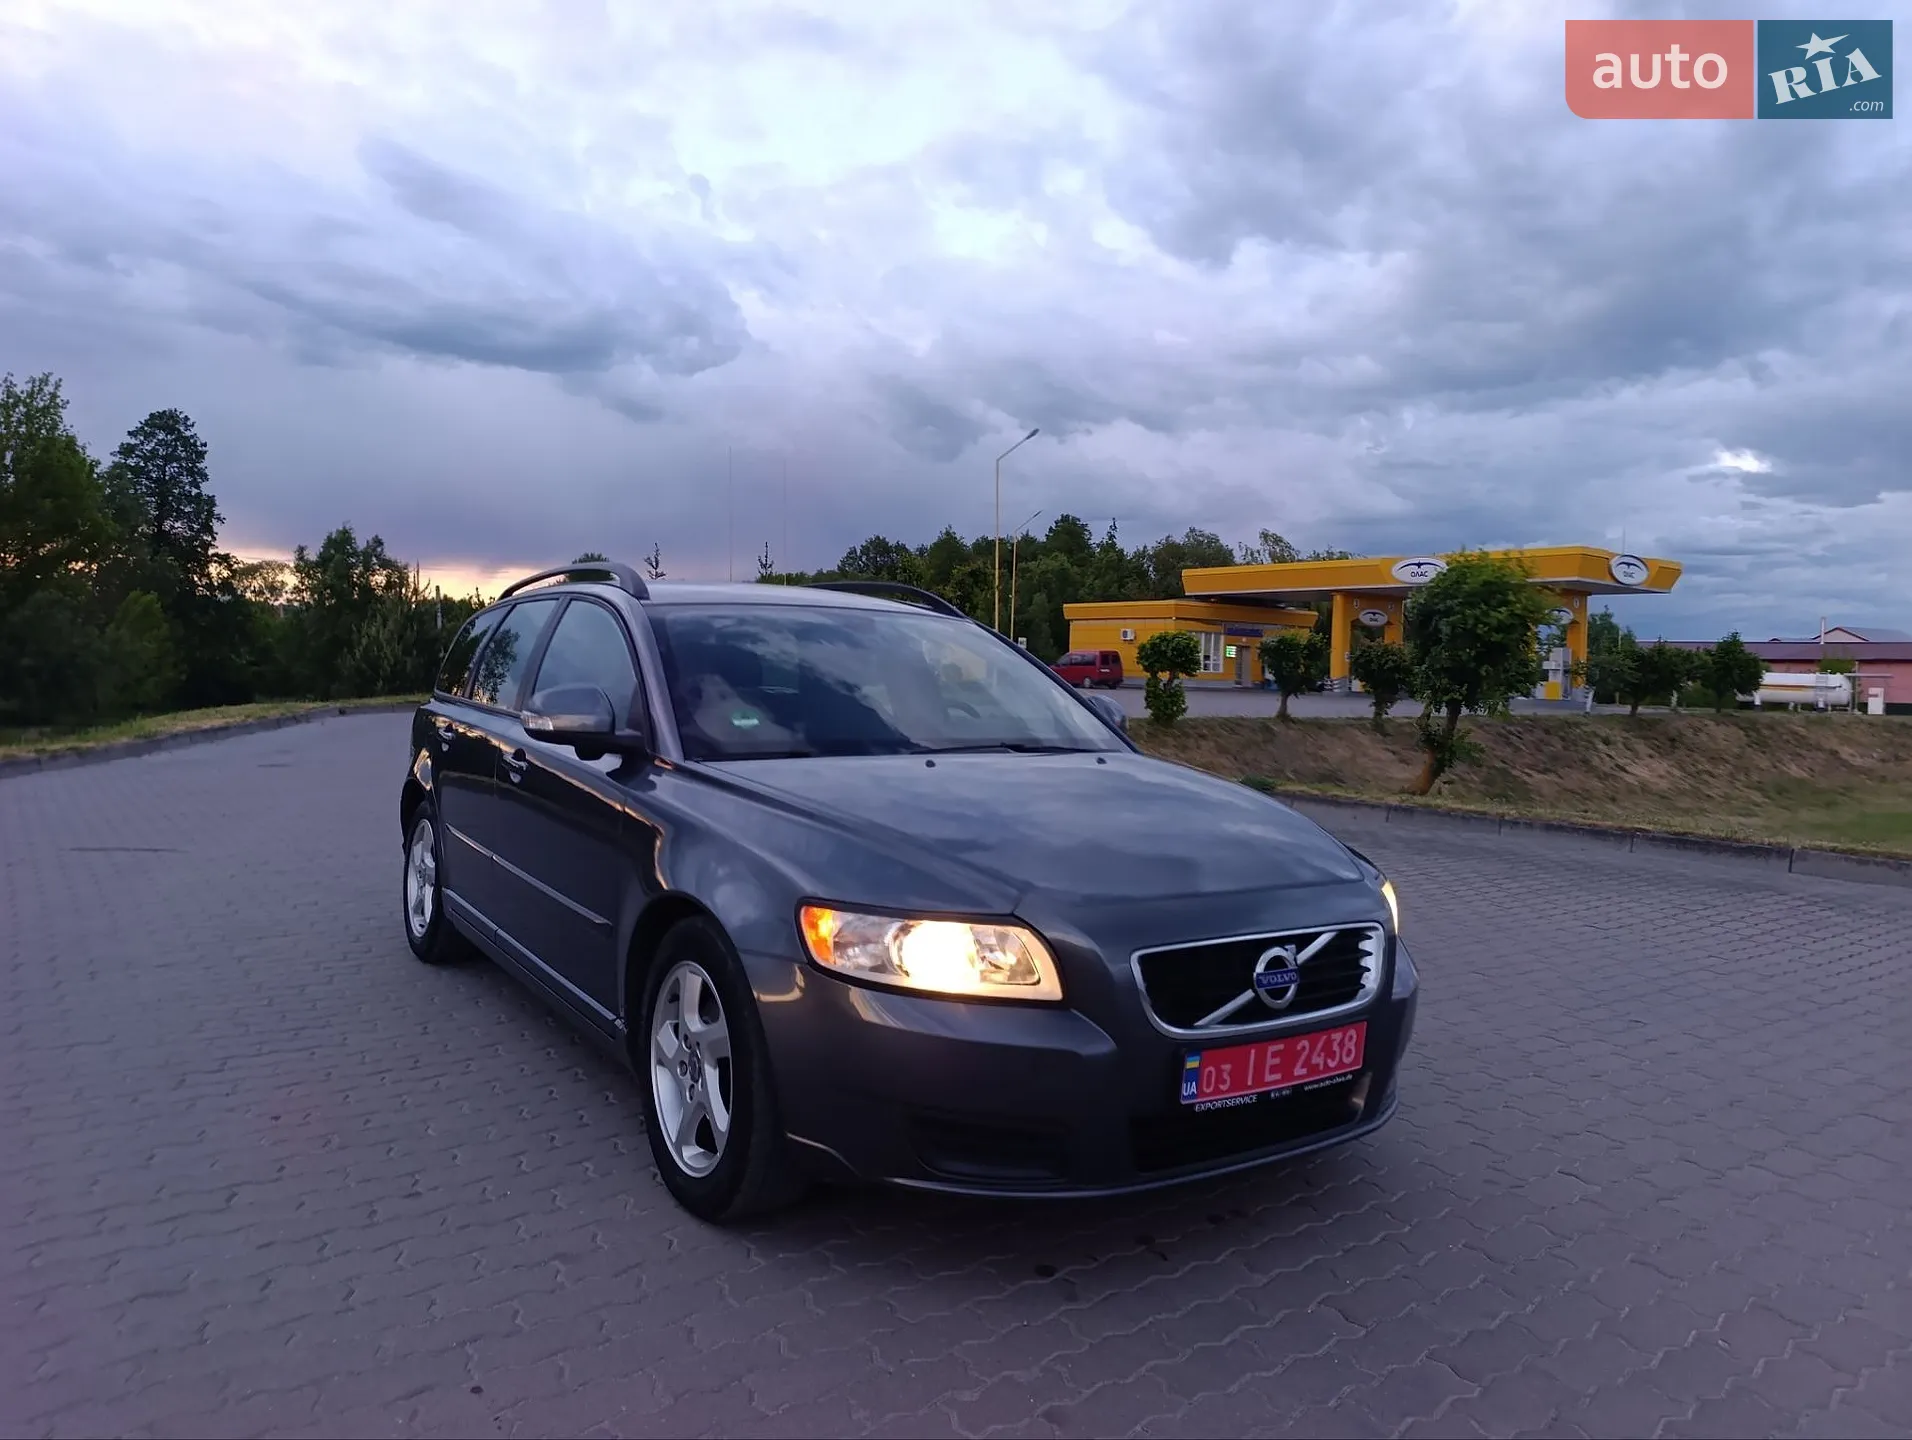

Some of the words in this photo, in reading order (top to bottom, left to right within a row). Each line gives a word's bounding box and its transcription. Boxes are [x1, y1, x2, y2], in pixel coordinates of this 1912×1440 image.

[1259, 972, 1297, 984] VOLVO
[1183, 1081, 1197, 1096] UA
[1203, 1063, 1232, 1093] 03
[1293, 1028, 1357, 1077] 2438
[1194, 1094, 1258, 1113] EXPORTSERVICE
